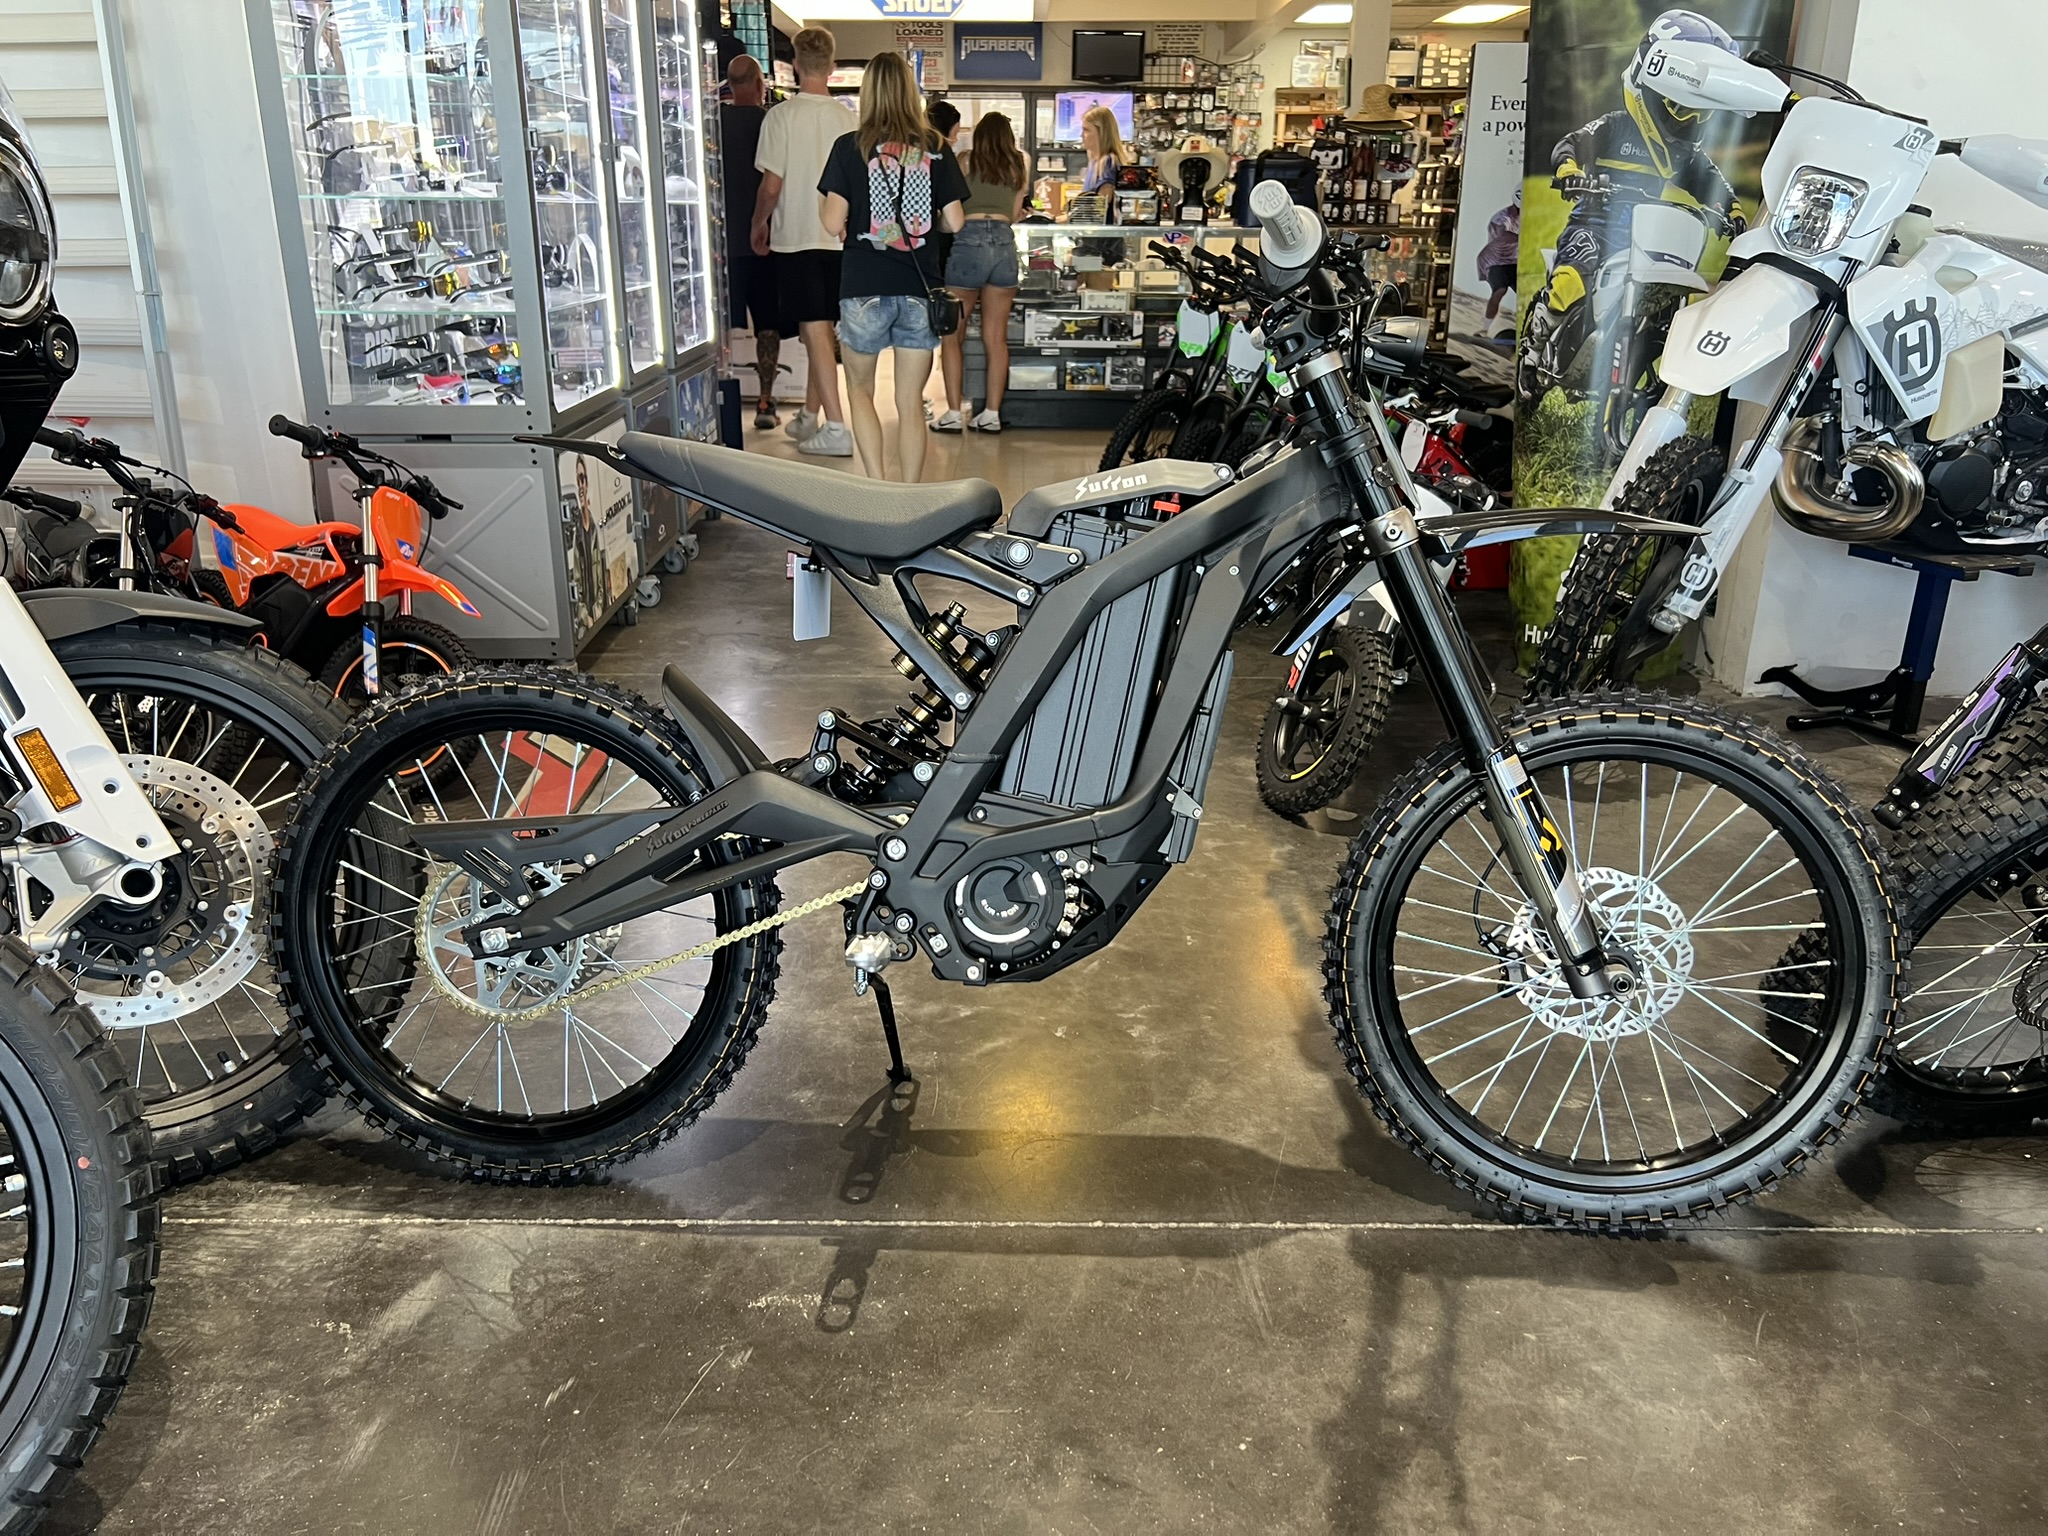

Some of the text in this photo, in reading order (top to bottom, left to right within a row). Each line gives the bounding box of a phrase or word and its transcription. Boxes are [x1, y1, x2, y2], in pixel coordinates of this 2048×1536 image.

[895, 28, 944, 36] LOANED
[960, 37, 1036, 61] HUSABERG
[1674, 68, 1702, 86] Husqvarna
[1482, 121, 1491, 132] a
[1910, 388, 1938, 404] Husqvarna
[688, 799, 730, 829] POWERPARTS
